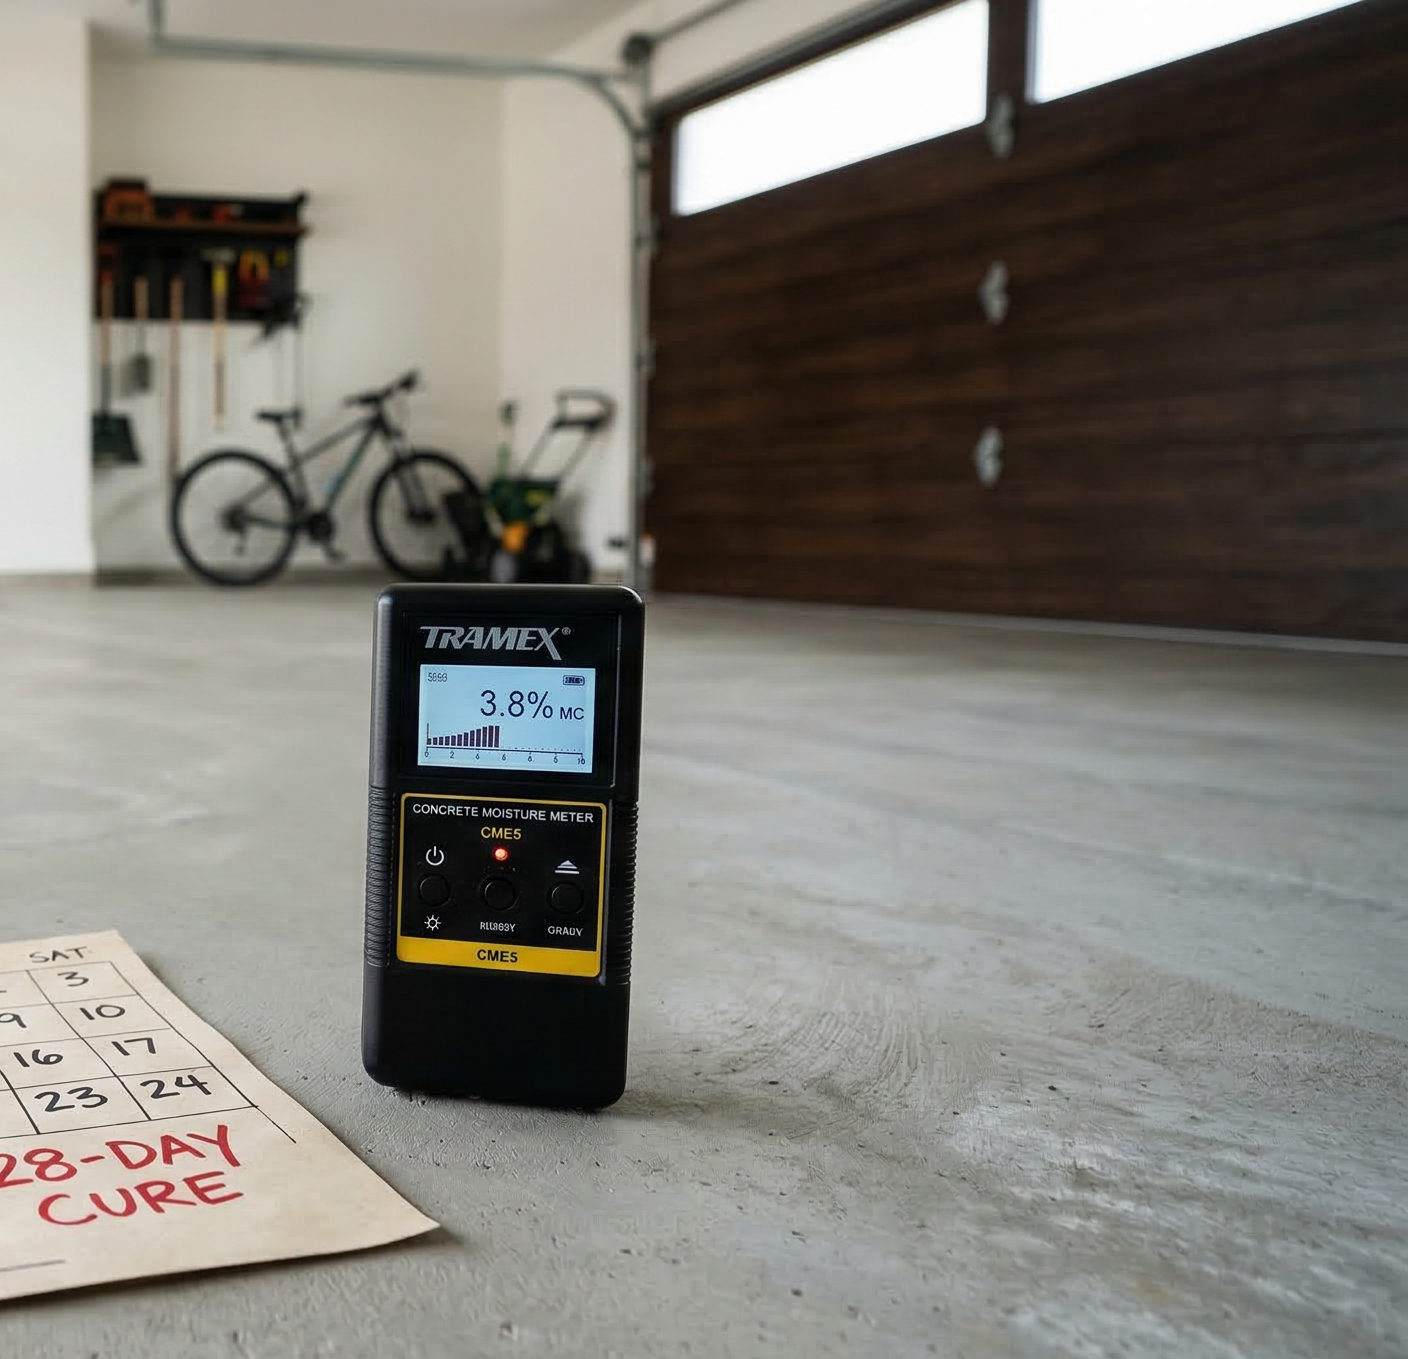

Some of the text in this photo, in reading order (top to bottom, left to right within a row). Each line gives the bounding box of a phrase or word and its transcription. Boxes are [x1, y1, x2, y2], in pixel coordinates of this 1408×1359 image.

[480, 690, 585, 721] 3.8% MC
[412, 803, 594, 824] CONCRETE MOISTURE METER
[480, 826, 522, 840] CME5
[29, 946, 91, 963] SAT
[476, 949, 518, 964] CME5
[57, 970, 90, 987] 3
[79, 1004, 126, 1021] 10
[13, 1049, 64, 1068] 16
[111, 1037, 157, 1057] 17
[35, 1086, 109, 1114] 23
[140, 1073, 213, 1102] 24
[37, 1170, 245, 1226] CURE
